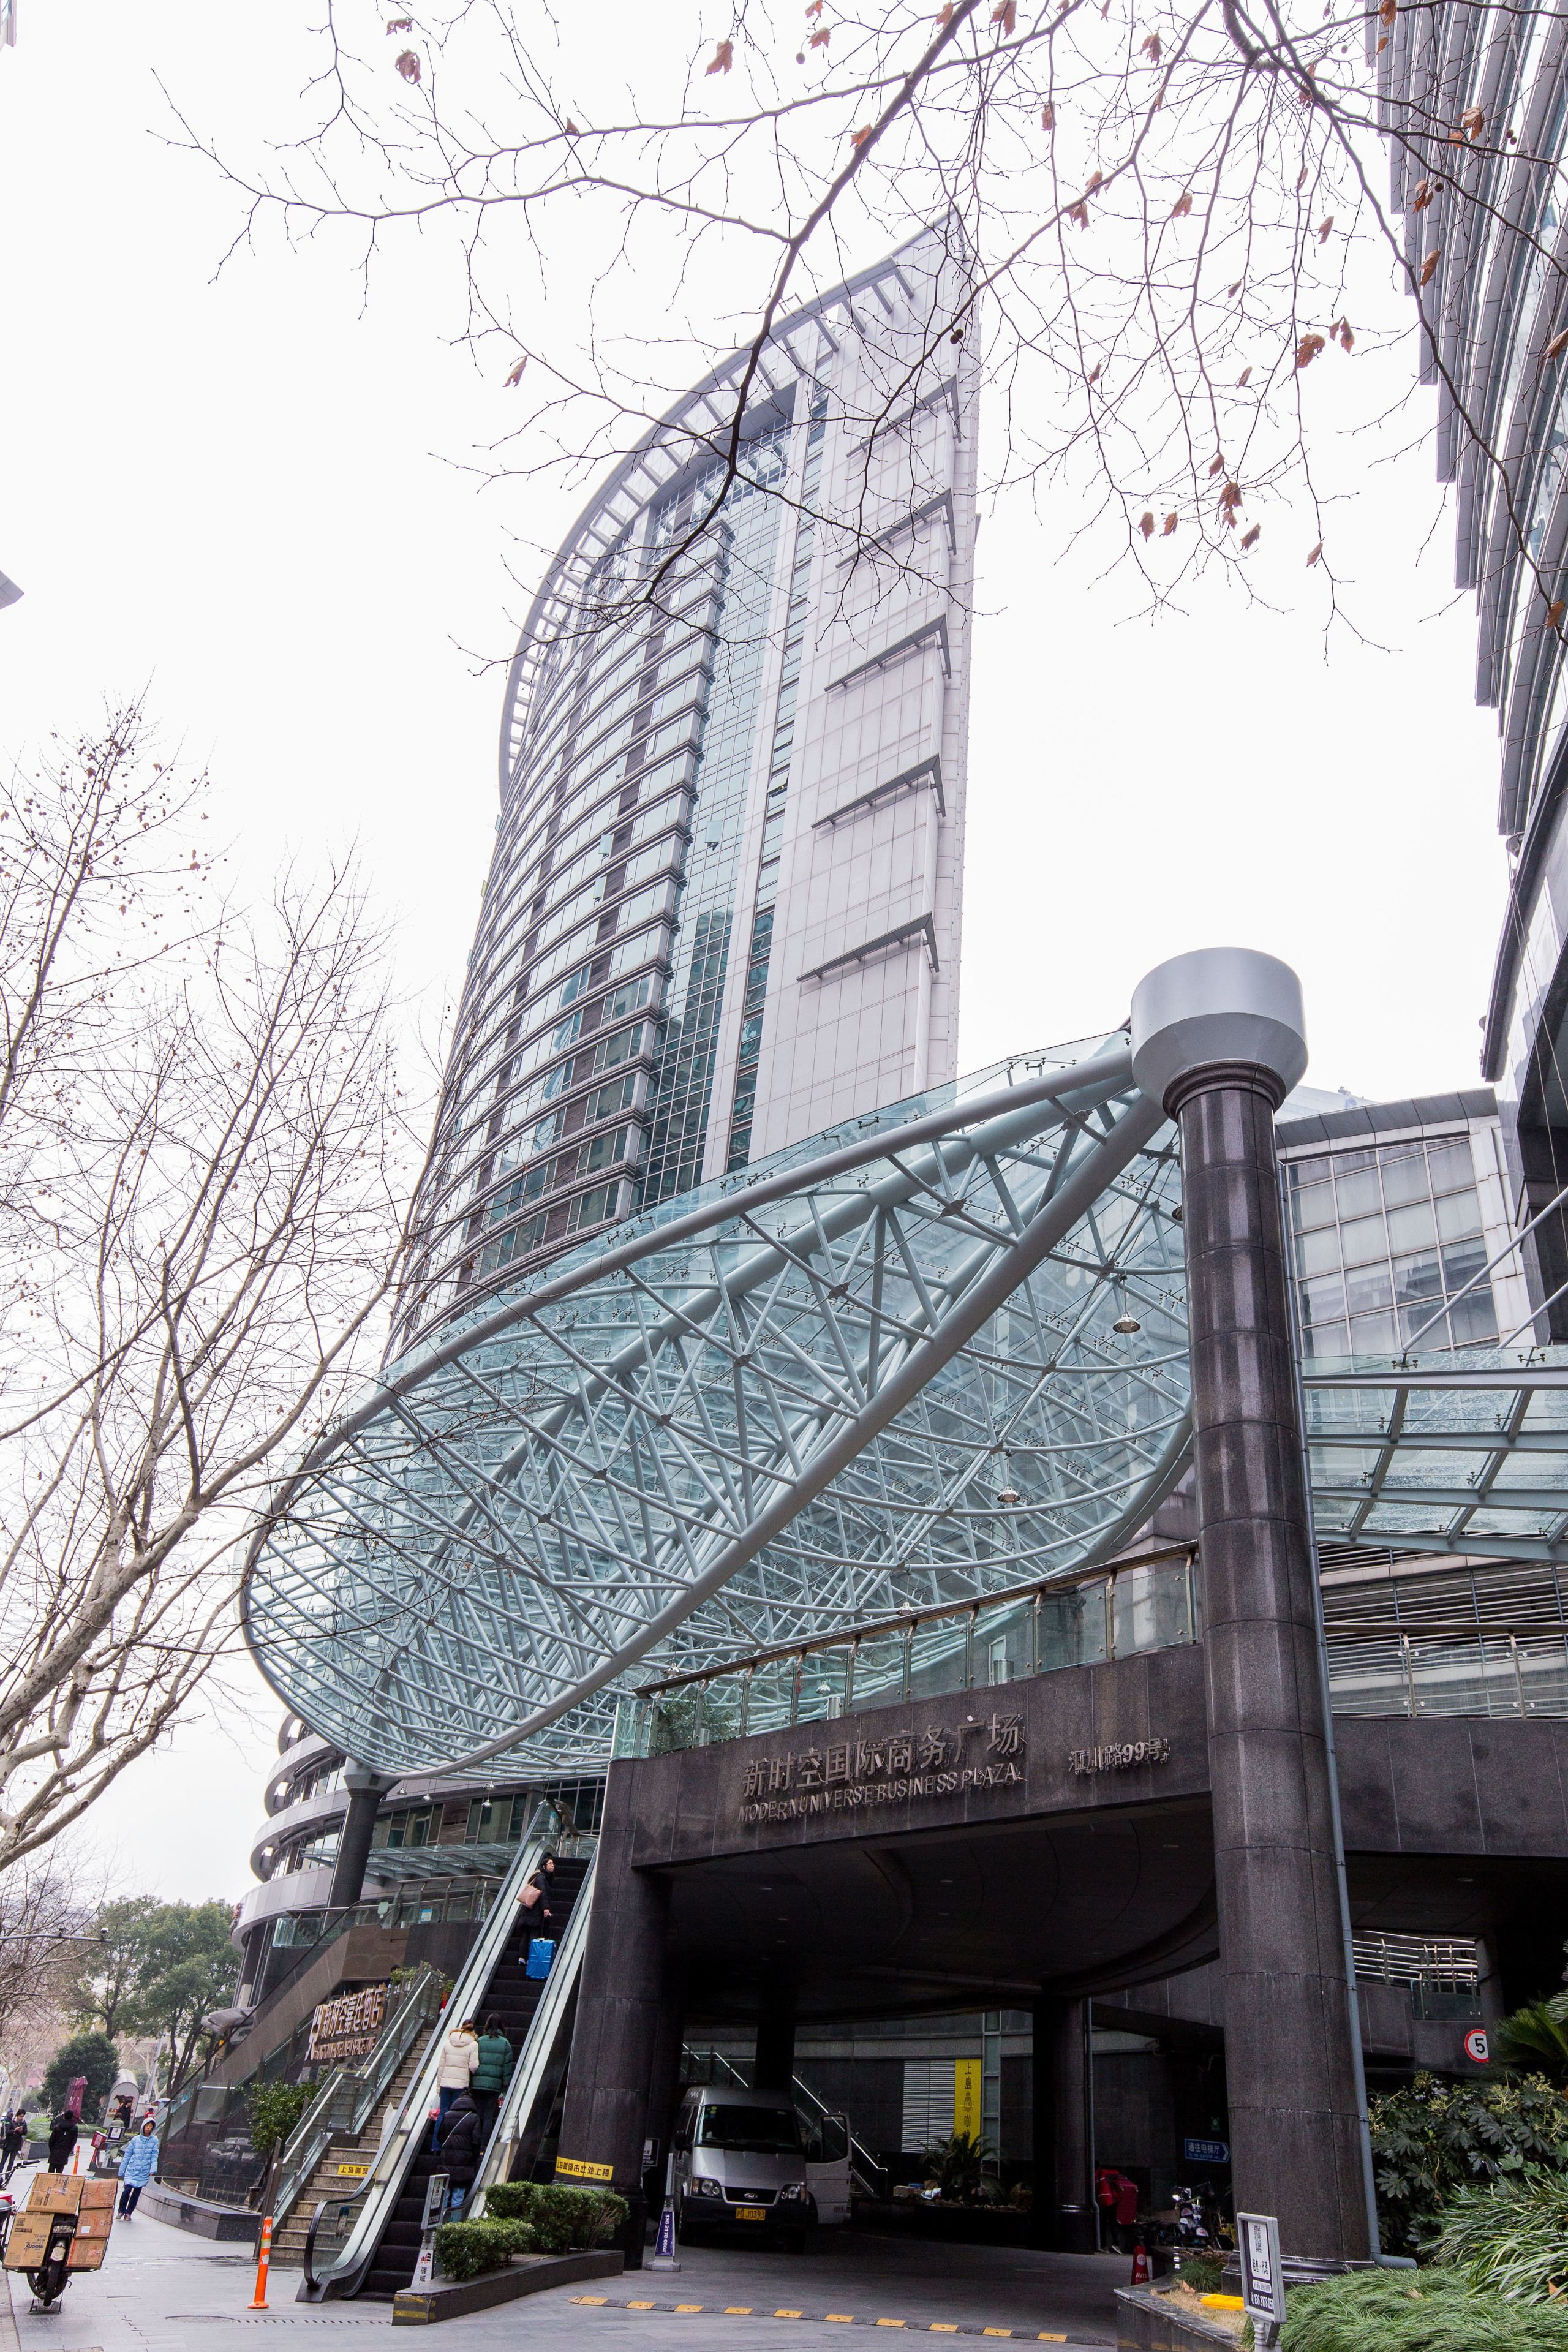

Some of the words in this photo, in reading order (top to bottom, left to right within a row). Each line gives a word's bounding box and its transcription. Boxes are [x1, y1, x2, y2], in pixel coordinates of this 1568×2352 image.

[742, 1713, 1020, 1798] 新时空国际商务广场
[1068, 1738, 1162, 1771] 汇川路99号
[738, 1799, 796, 1822] MODERN
[799, 1785, 874, 1813] UNIVERSE
[877, 1772, 958, 1802] BUSINESS
[962, 1762, 1018, 1789] PLAZA
[1474, 2037, 1485, 2054] 5
